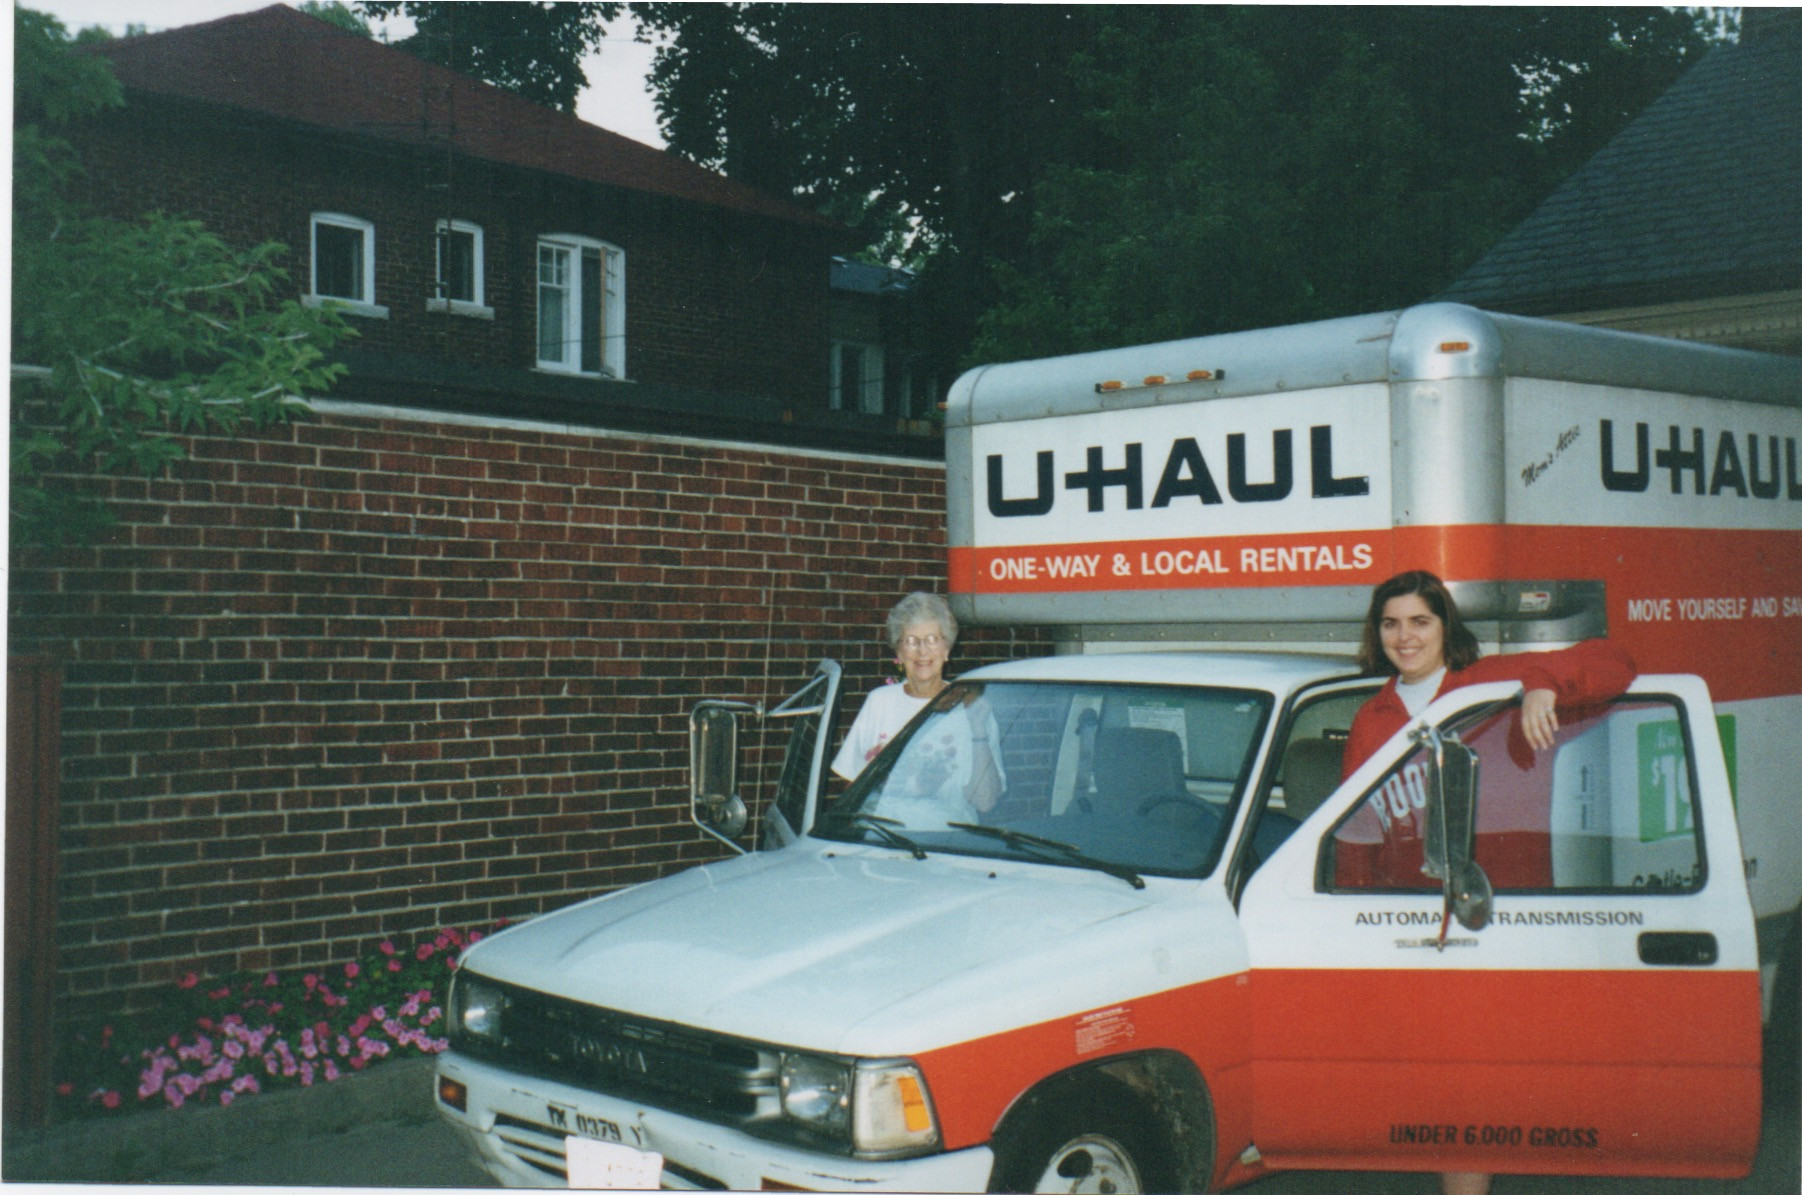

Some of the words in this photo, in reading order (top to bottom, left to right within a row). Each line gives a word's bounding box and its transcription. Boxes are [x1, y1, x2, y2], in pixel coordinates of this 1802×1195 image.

[986, 424, 1370, 518] U-HAUL
[989, 553, 1101, 581] ONE-WAY
[1112, 553, 1132, 577] &
[1140, 549, 1229, 575] LOCAL
[1240, 543, 1373, 573] RENTALS
[1627, 599, 1672, 621] MOVE
[1677, 598, 1747, 620] YOURSELF
[1752, 597, 1778, 618] AND
[1782, 597, 1801, 617] SA
[1355, 911, 1443, 926] AUTOMA
[1389, 1124, 1458, 1145] UNDER
[1529, 1126, 1599, 1148] GROSS
